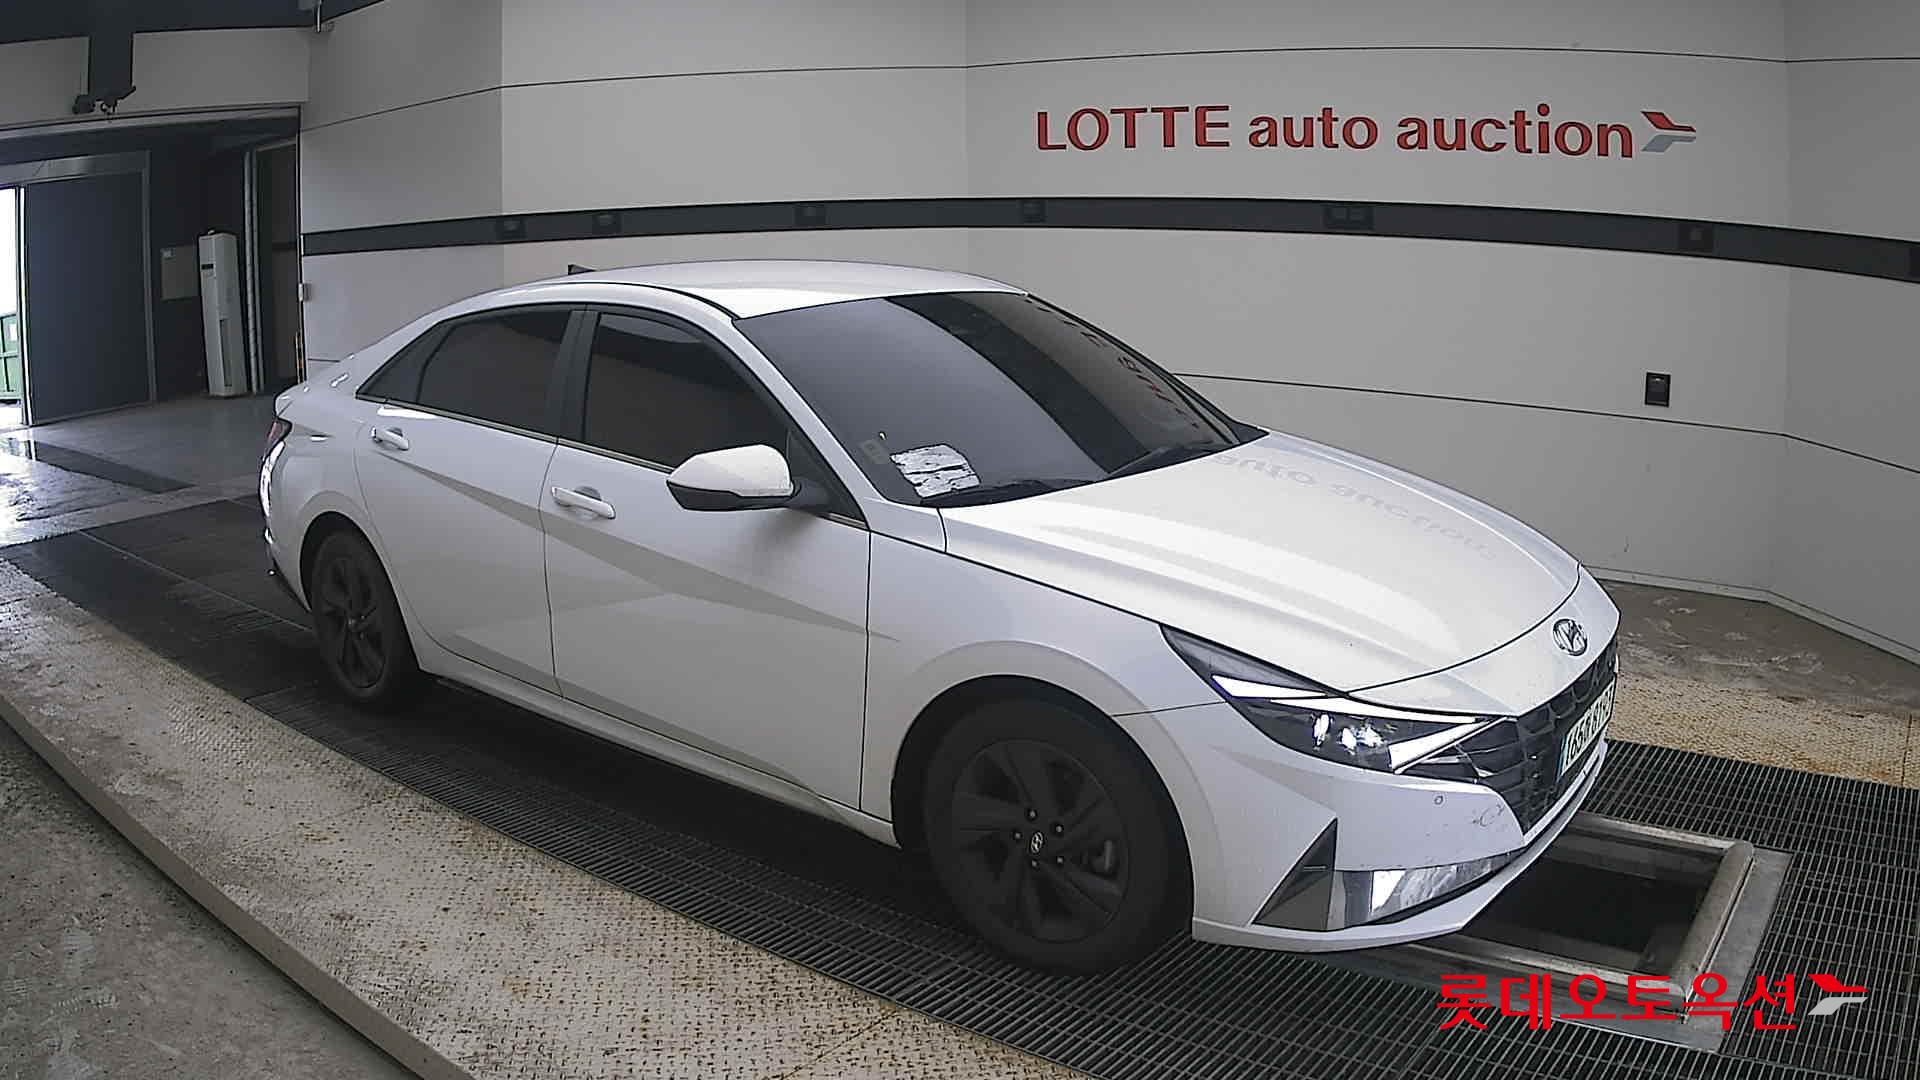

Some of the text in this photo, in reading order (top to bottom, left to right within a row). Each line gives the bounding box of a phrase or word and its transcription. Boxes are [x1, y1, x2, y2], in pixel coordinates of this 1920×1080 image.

[1035, 103, 1635, 158] LOTTE auto auction
